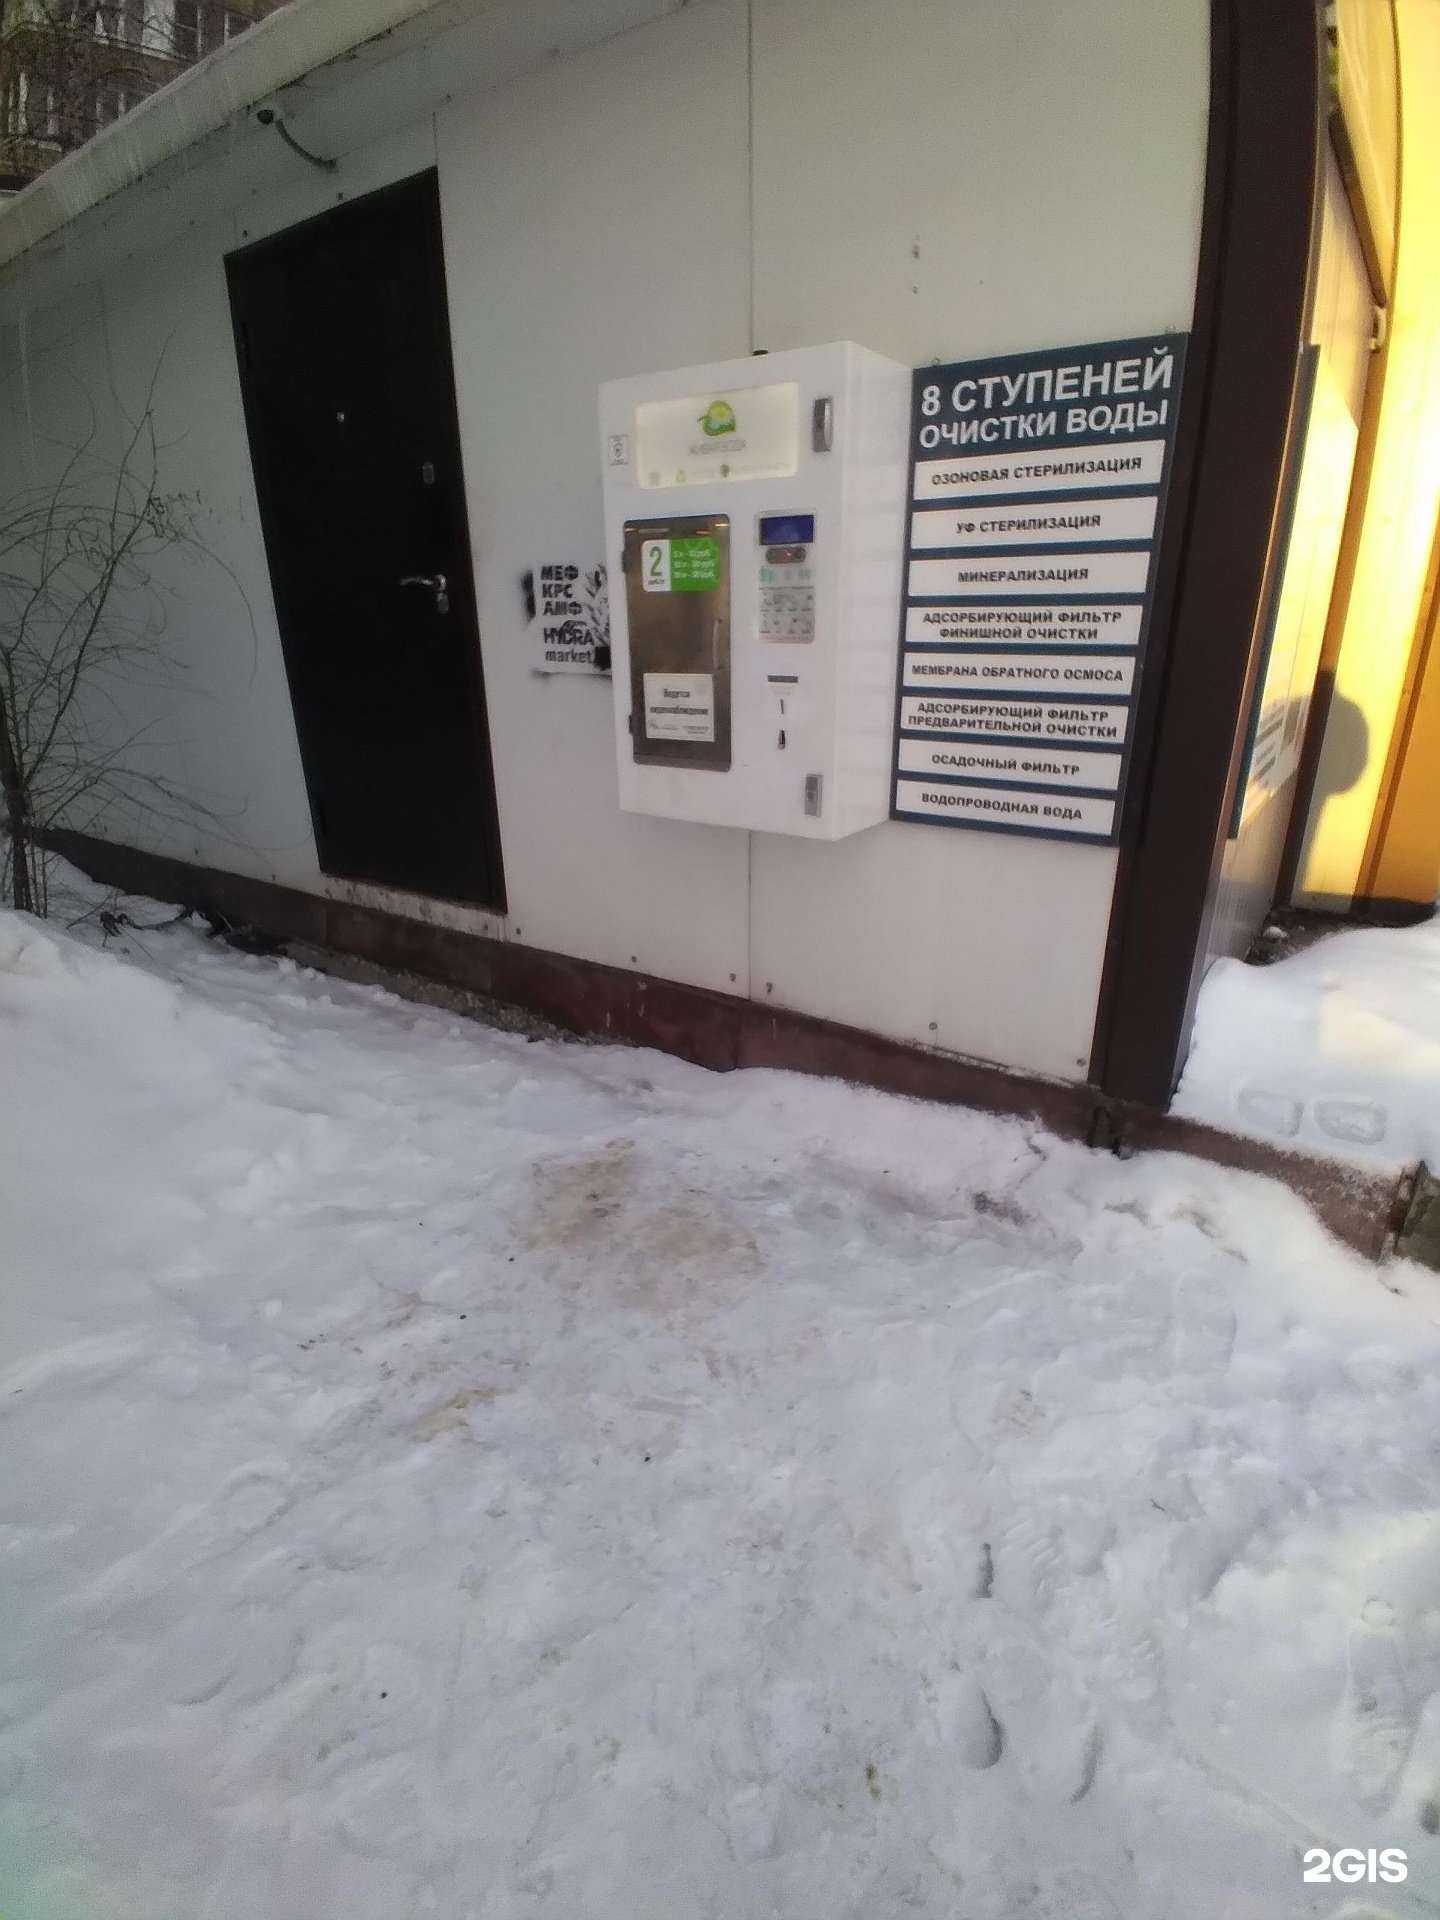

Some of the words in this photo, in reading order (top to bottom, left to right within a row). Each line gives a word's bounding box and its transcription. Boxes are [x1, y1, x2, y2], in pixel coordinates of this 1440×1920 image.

[921, 385, 941, 416] 8
[952, 345, 1174, 412] СТУПЕНЕЙ
[919, 410, 1057, 448] ОЧИСТКИ
[1066, 399, 1168, 434] ВОДЫ
[931, 465, 1009, 485] ОЗОНОВАЯ
[1014, 457, 1142, 480] СТЕРИЛИЗАЦИЯ
[956, 522, 976, 533] УФ
[980, 515, 1101, 532] СТЕРИЛИЗАЦИЯ
[649, 546, 662, 576] 2
[541, 564, 579, 580] МЕФ
[958, 568, 1089, 582] МИНЕРАЛИЗАЦИЯ
[922, 611, 1053, 625] АДСОРБИРУЮЩИЙ
[1058, 612, 1122, 623] ФИЛЬТР
[543, 625, 594, 645] HYDRA
[939, 626, 1023, 639] ФИНИШНОЙ
[1027, 628, 1098, 640] ОЧИСТКИ
[545, 648, 593, 664] market
[912, 664, 978, 677] МЕМБРАНА
[982, 666, 1060, 680] ОБРАТНОГО
[1063, 668, 1124, 682] ОСМОСА
[917, 702, 1043, 719] АДСОРБИРУЮЩИЙ
[1047, 708, 1109, 722] ФИЛЬТР
[908, 716, 1042, 733] ПРЕДВАРИТЕЛЬНОЙ
[1046, 724, 1117, 738] ОЧИСТКИ
[931, 753, 1017, 770] ОСАДОЧНЫЙ
[1021, 760, 1080, 776] ФИЛЬТР
[921, 792, 1039, 815] ВОДОПРОВОДНАЯ
[1043, 805, 1082, 820] ВОДА
